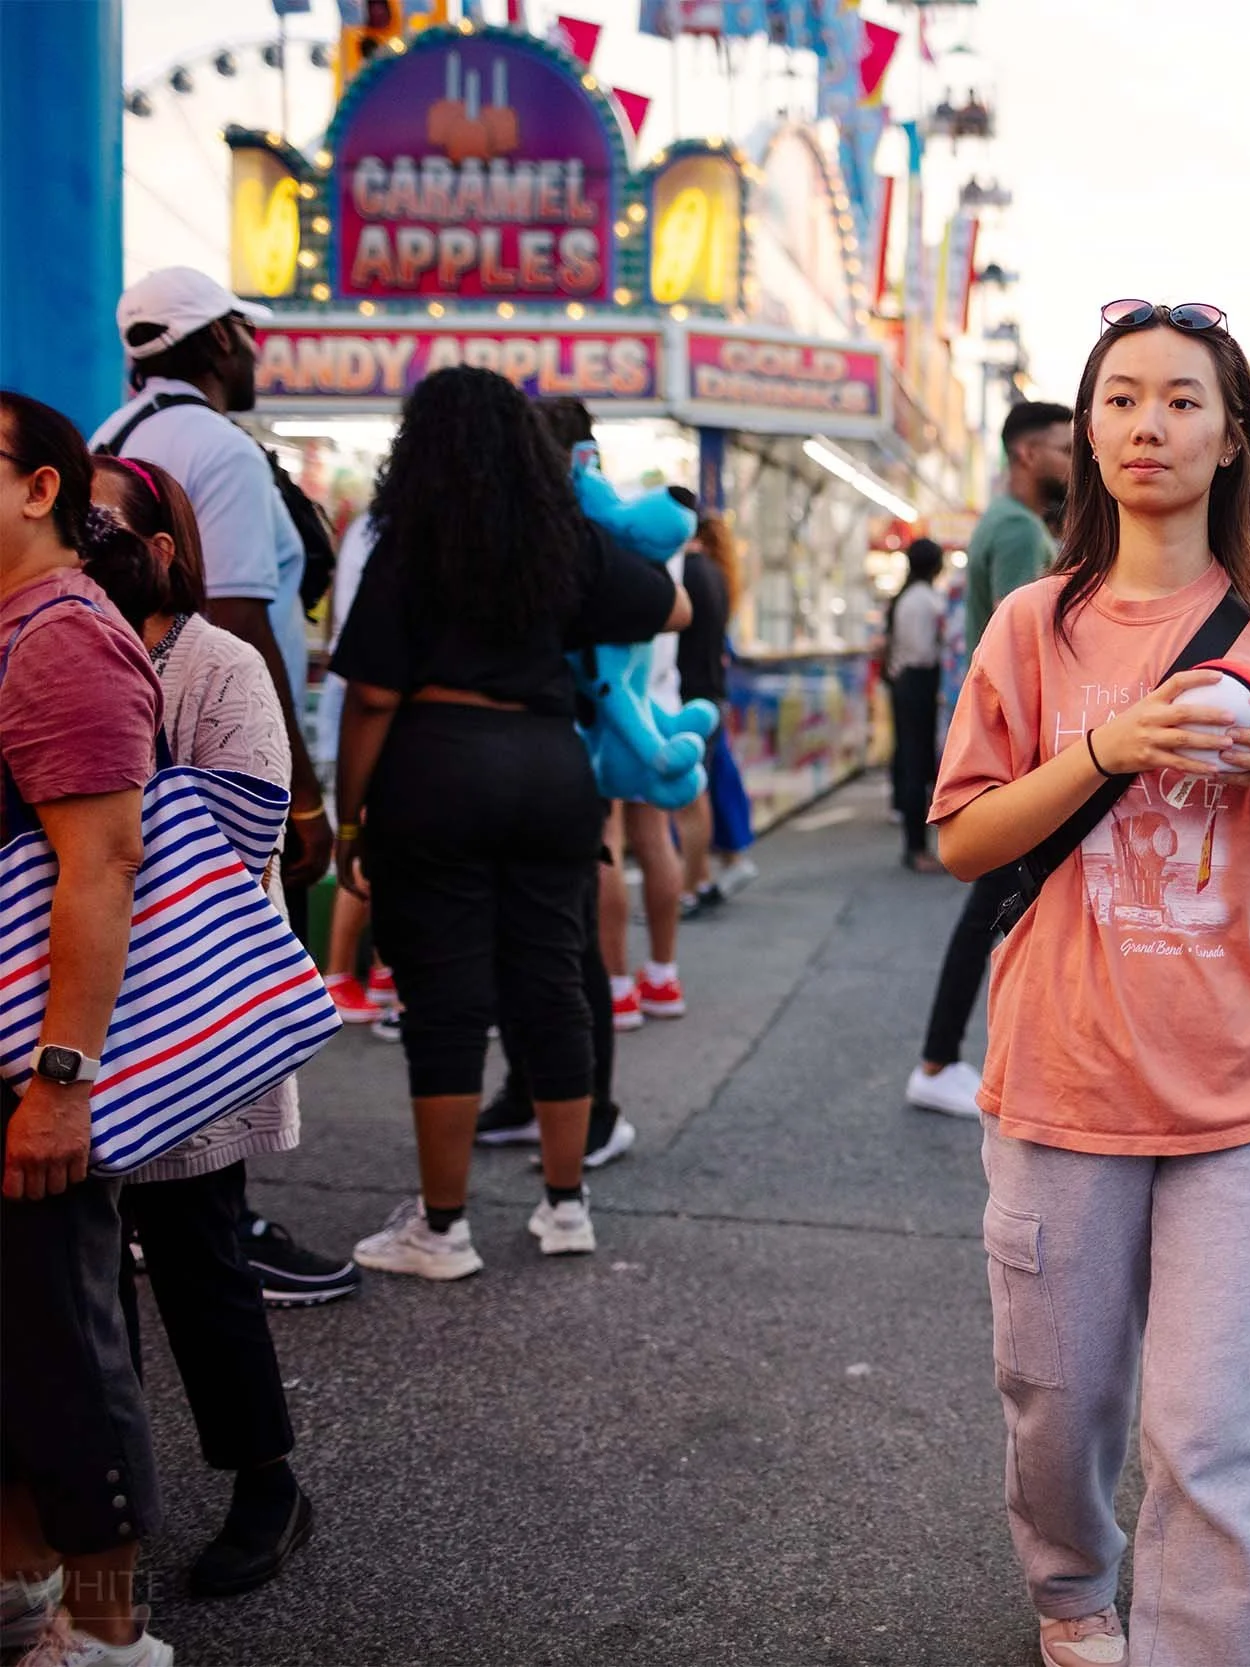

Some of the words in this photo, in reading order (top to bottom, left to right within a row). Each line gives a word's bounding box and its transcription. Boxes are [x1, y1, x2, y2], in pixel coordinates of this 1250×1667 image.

[354, 156, 599, 224] CARAMEL
[352, 225, 601, 294] APPLES
[255, 335, 417, 394] ANDY
[720, 341, 847, 382] COLD
[1080, 684, 1130, 705] This
[1120, 938, 1156, 956] Grand
[1155, 940, 1184, 956] Bend
